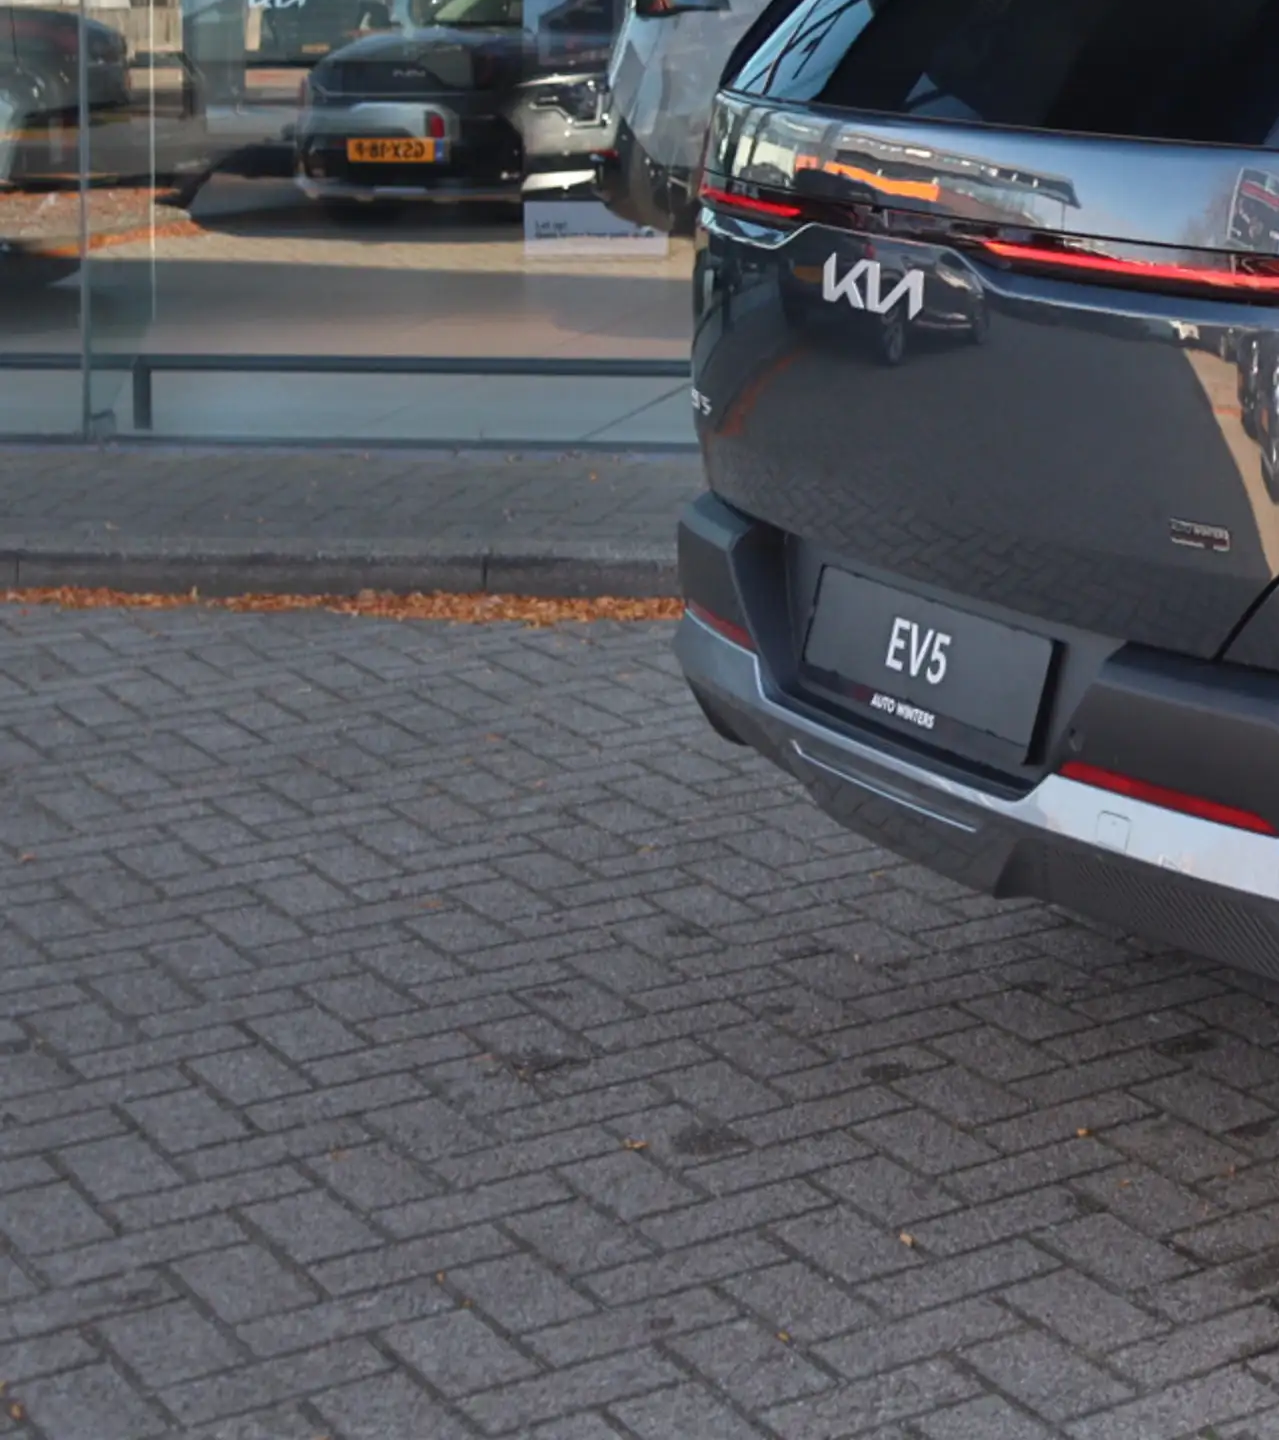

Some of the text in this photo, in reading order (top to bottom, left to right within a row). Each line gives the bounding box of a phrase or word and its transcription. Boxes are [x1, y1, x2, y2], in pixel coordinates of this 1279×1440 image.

[822, 252, 924, 320] KIA
[885, 617, 952, 684] EV5
[870, 692, 936, 729] AUTO WINTERS
